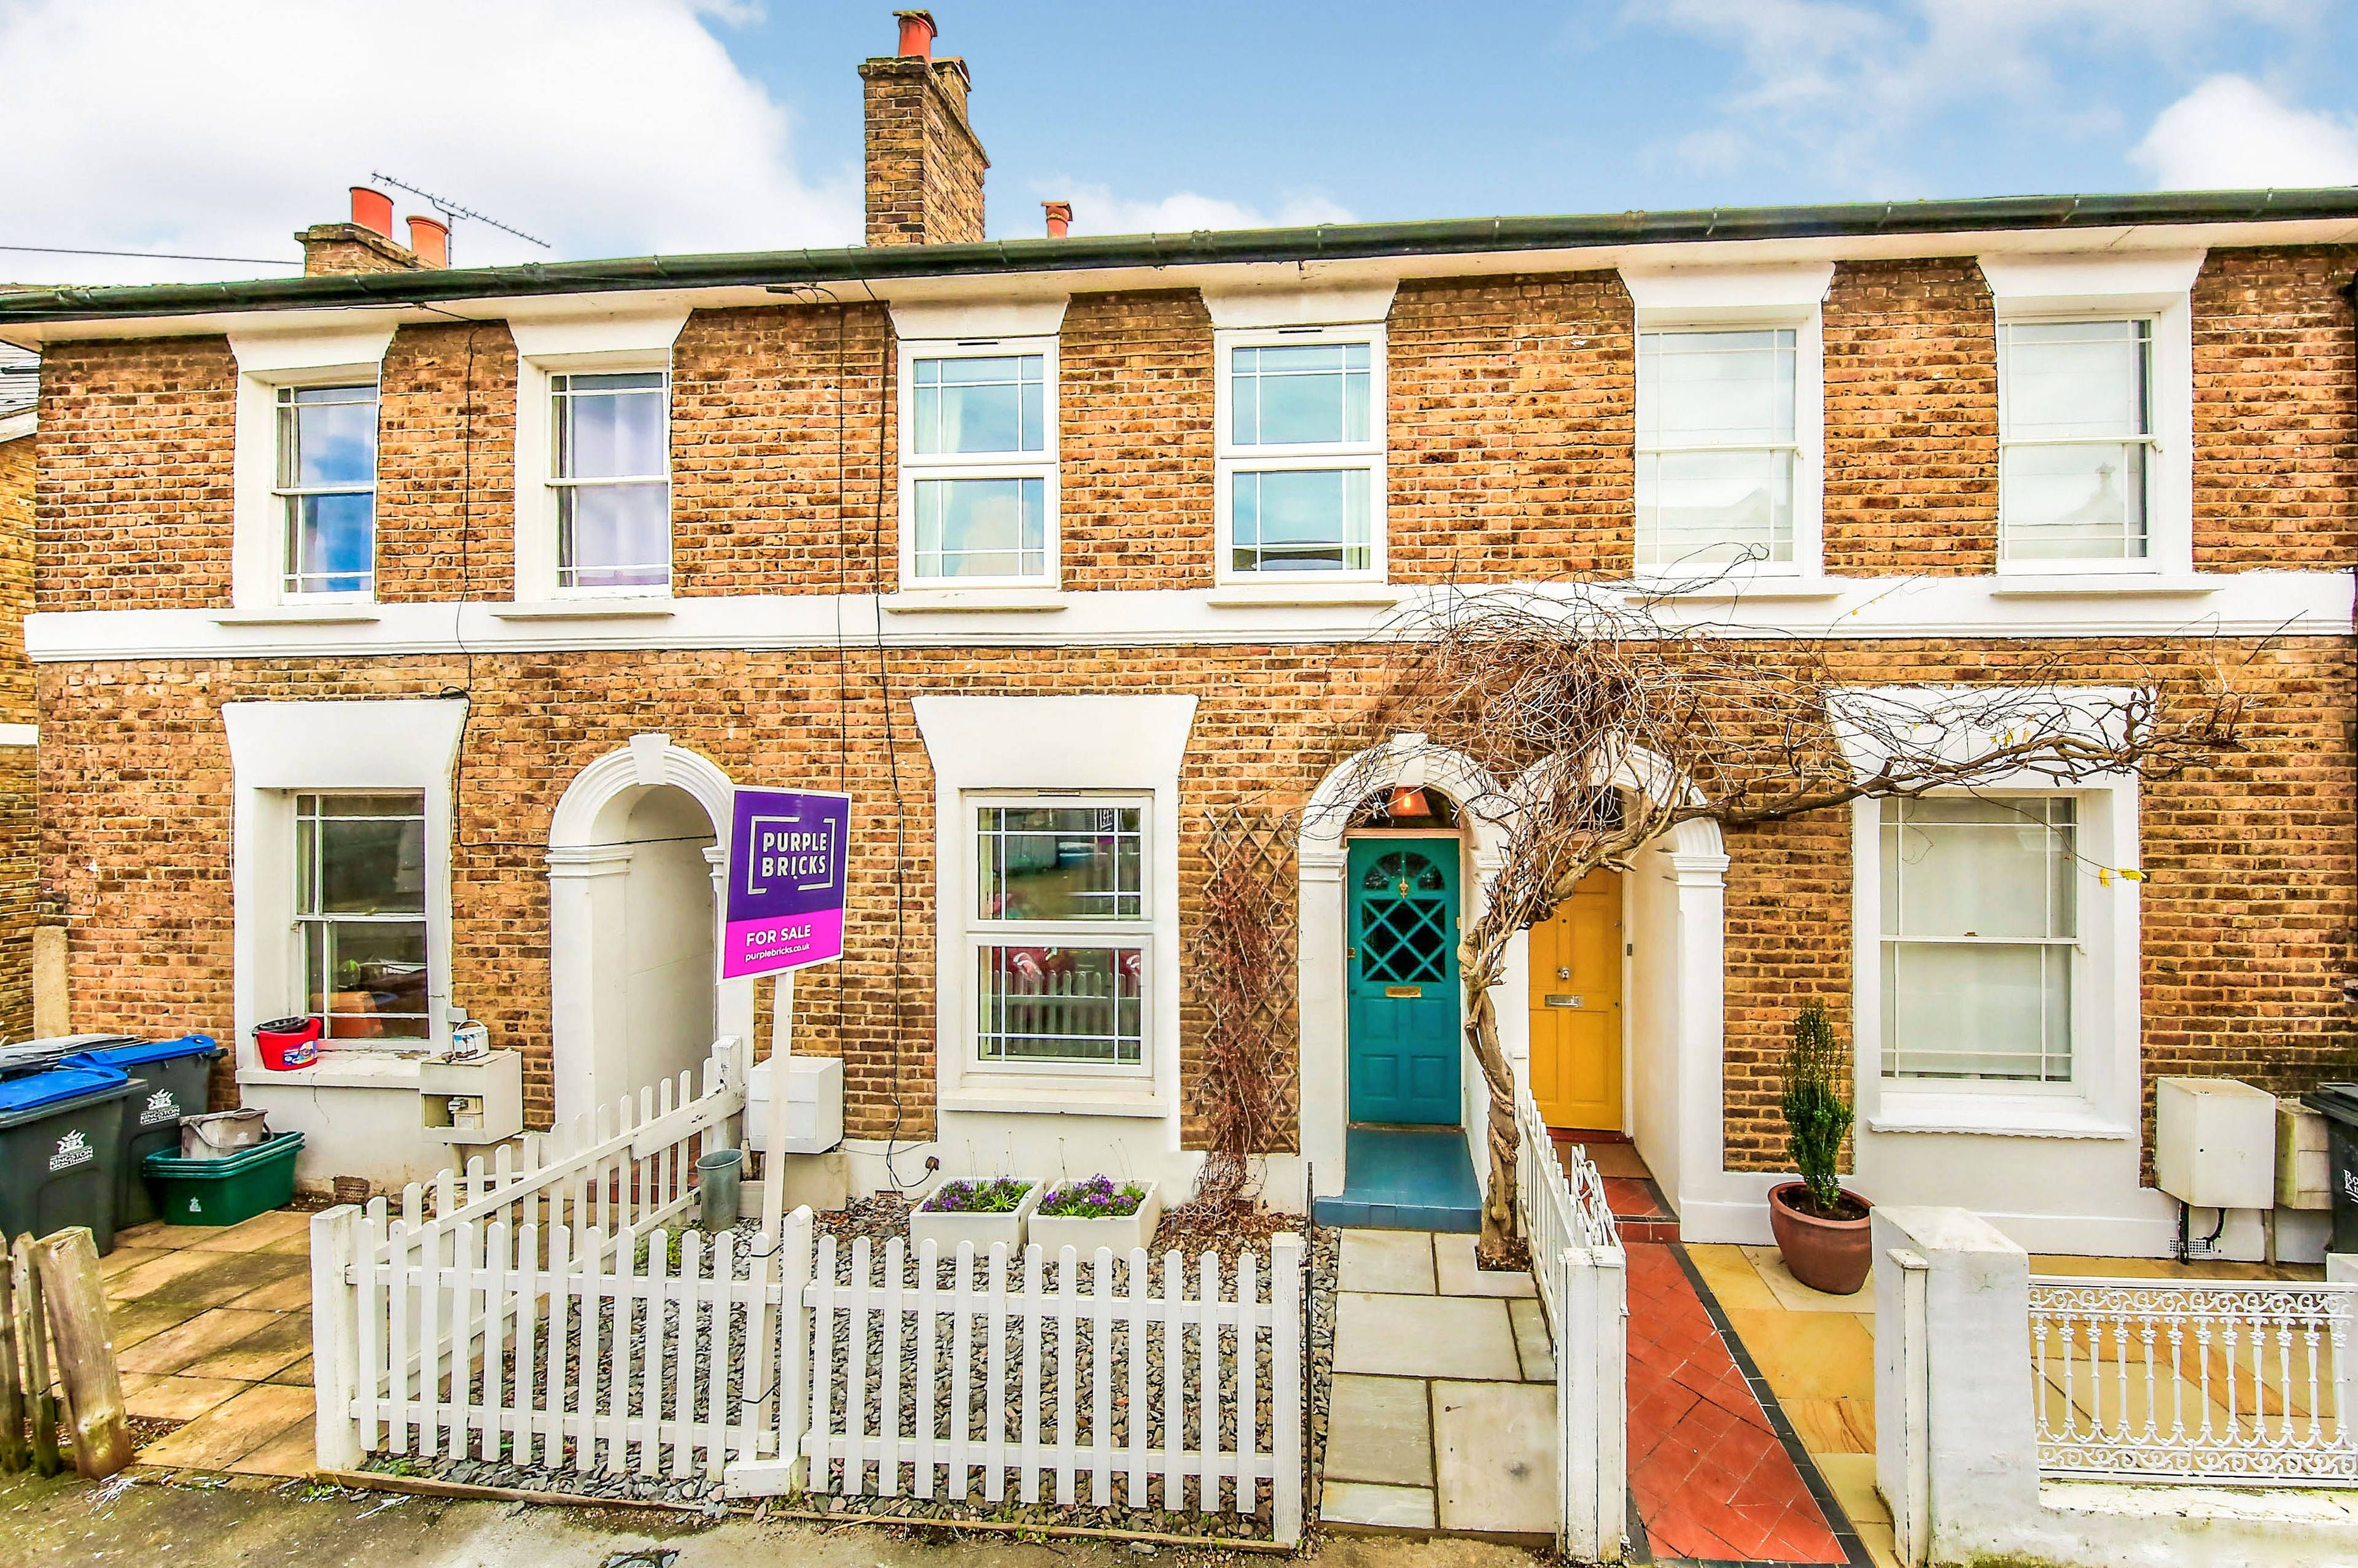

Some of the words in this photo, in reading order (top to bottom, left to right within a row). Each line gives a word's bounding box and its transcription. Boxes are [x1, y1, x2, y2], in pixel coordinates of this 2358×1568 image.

[763, 832, 828, 853] PURPLE
[761, 855, 827, 880] BRICKS
[746, 930, 777, 947] FOR
[780, 924, 812, 941] SALE
[745, 942, 811, 963] purplebricks.co.uk
[141, 1108, 180, 1120] KINGSTON
[50, 1149, 93, 1165] KINGSTON
